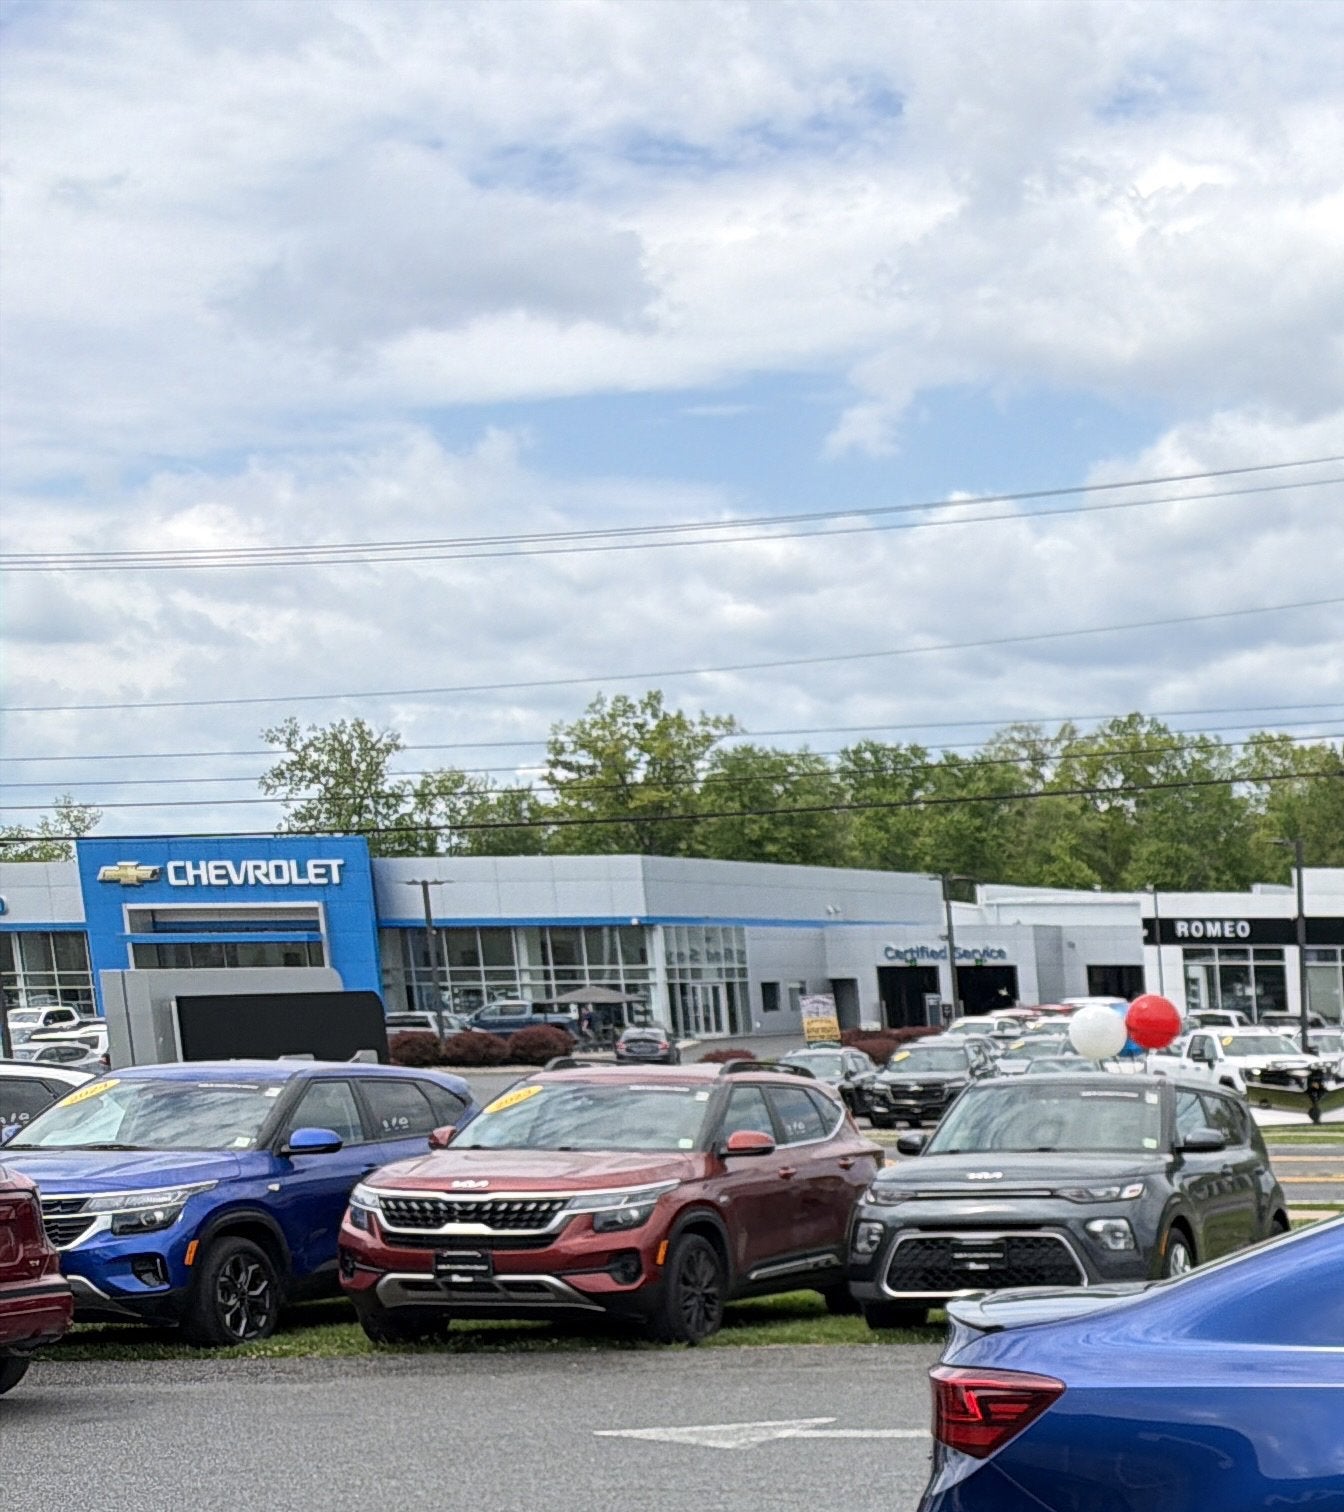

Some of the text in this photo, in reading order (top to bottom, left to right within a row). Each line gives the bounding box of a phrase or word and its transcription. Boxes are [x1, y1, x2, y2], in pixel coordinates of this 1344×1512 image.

[166, 859, 345, 886] CHEVROLET
[1175, 921, 1251, 938] ROMEO
[885, 945, 1006, 961] Certified Service
